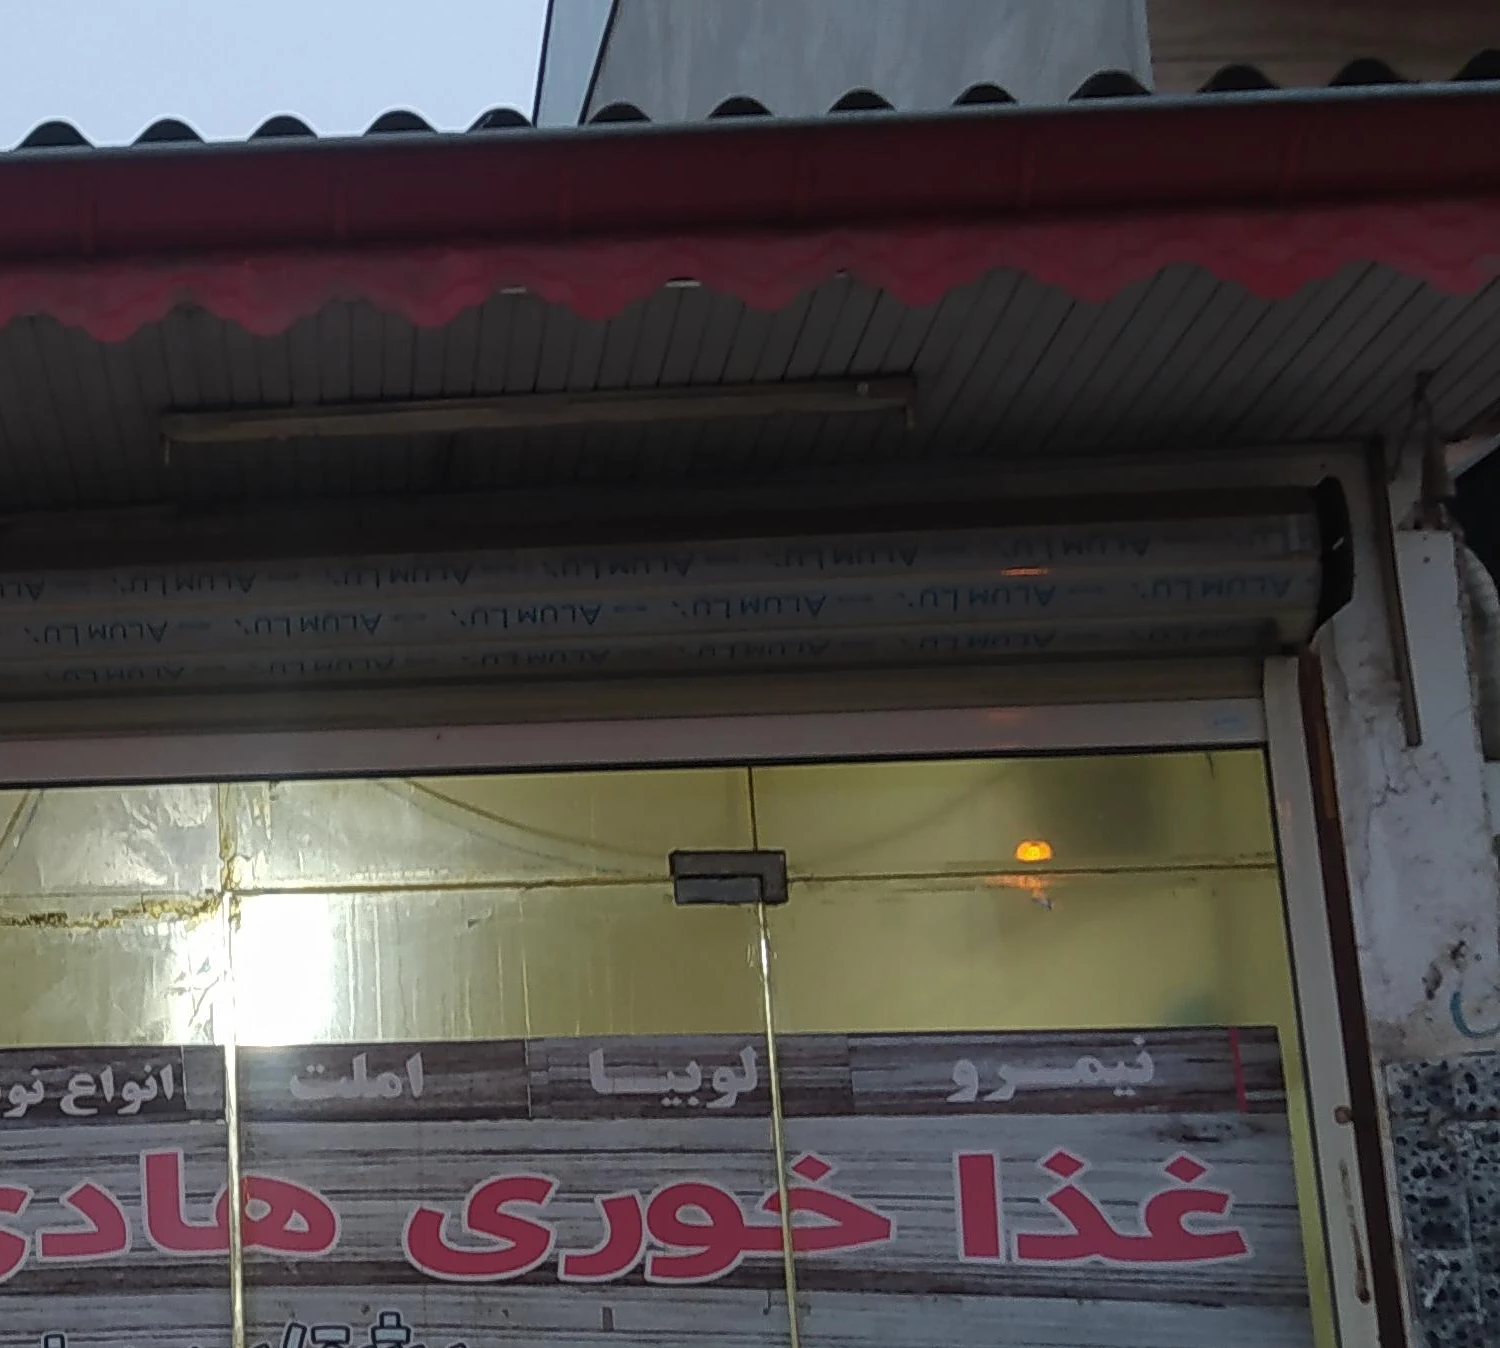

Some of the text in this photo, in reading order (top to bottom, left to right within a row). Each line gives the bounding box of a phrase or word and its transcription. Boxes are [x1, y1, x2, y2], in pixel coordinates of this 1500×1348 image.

[462, 649, 610, 669] ALUMLU
[678, 640, 830, 661] ALUMLU
[900, 631, 1057, 652] ALUMLU
[59, 1062, 175, 1116] انواع
[289, 1051, 425, 1101] املت
[587, 1044, 761, 1109] لوبیا
[945, 1034, 1157, 1104] نیمرو
[403, 1150, 894, 1283] خوری
[952, 1148, 1257, 1270] غذا
